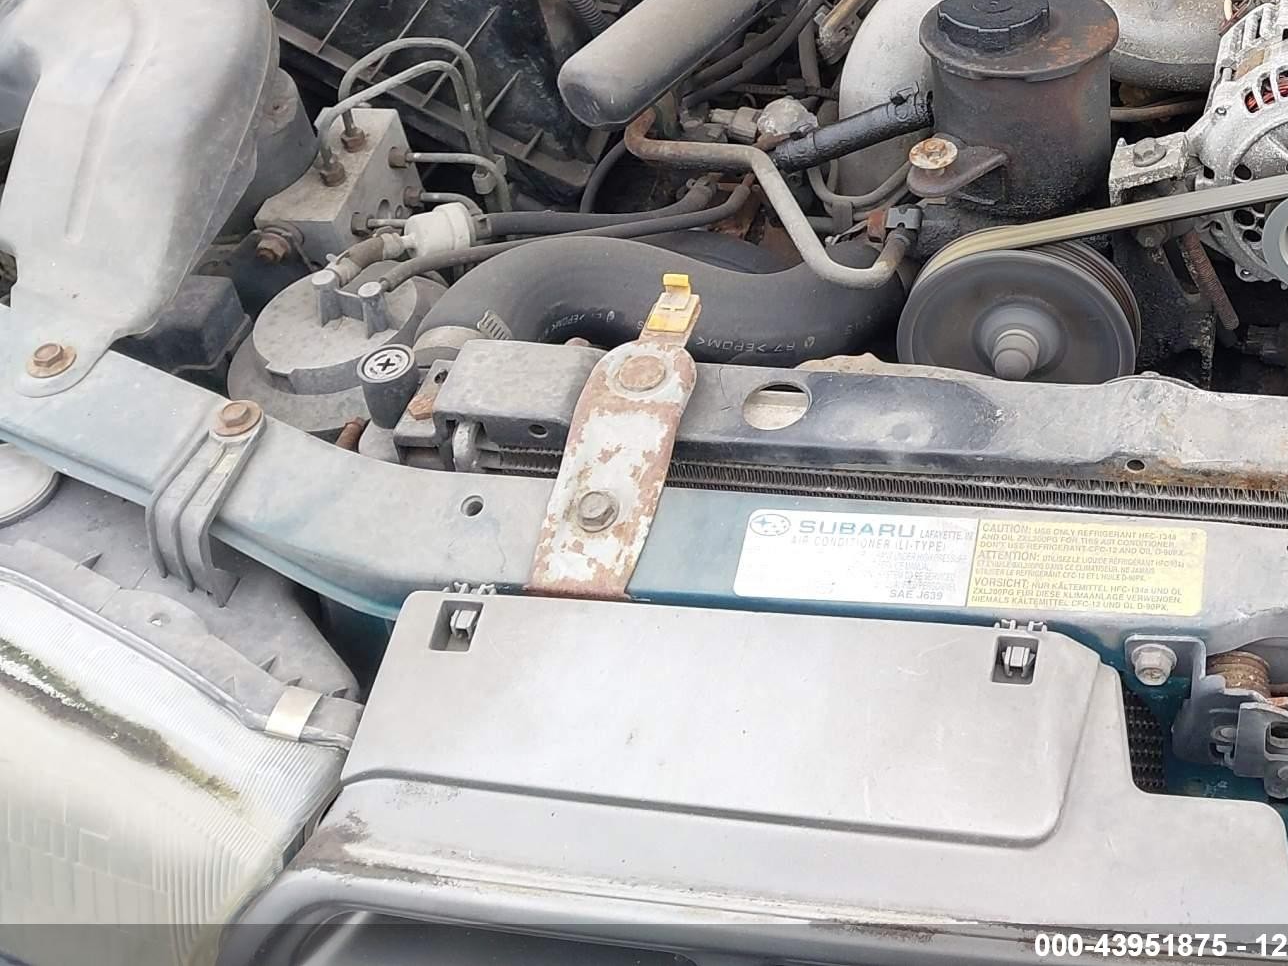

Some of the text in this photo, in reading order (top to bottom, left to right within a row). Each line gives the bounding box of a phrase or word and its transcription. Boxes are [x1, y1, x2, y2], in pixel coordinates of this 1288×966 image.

[798, 520, 916, 538] SUBARU
[982, 522, 1031, 534] CAUTION:
[1053, 528, 1075, 536] ONLY
[1077, 529, 1136, 538] REFRIGERANT
[790, 536, 810, 546] AIR
[814, 536, 891, 550] CONDITIONER
[1060, 536, 1078, 544] FOR
[1024, 543, 1086, 552] REFRIGERANT
[976, 550, 1040, 562] ATTENTION:
[974, 577, 1030, 590] VORSICHT:
[1032, 582, 1050, 590] NUR
[1151, 587, 1169, 595] UND
[889, 588, 944, 601] SAE J639
[1036, 590, 1060, 598] DIESE
[970, 595, 1010, 604] NIEMALS
[1102, 601, 1120, 609] UND
